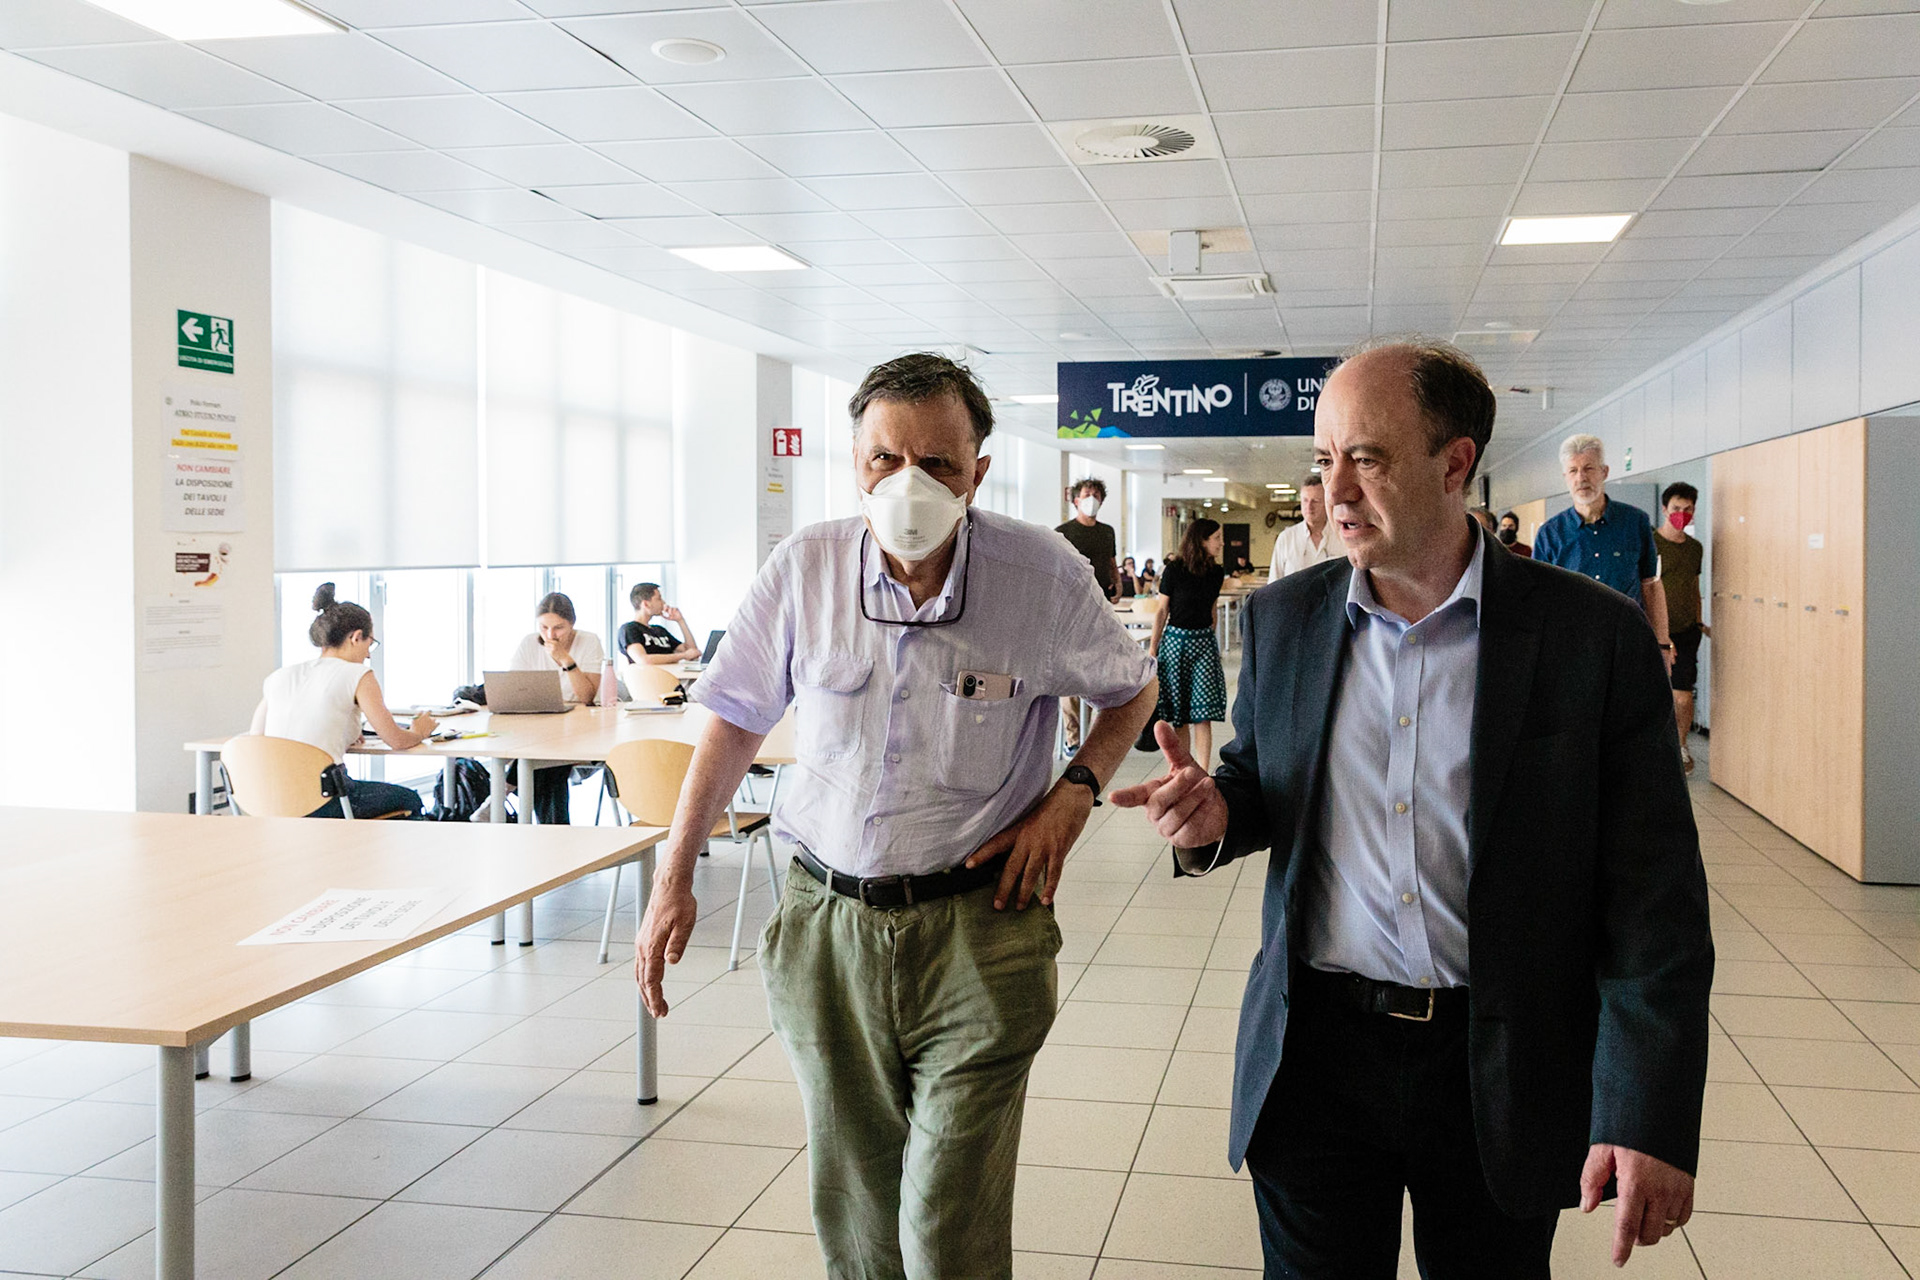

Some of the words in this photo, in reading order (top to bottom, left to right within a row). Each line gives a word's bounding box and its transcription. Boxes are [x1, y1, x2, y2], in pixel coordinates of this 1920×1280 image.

[1107, 381, 1233, 417] TRENTINO
[1297, 396, 1315, 411] DI
[176, 463, 193, 472] NON
[195, 464, 231, 474] CAMBIARE
[175, 478, 184, 486] LA
[186, 478, 233, 489] DISPOSIZIONE
[183, 492, 195, 501] DEI
[184, 507, 206, 516] DELLE
[207, 508, 225, 516] SEDIE
